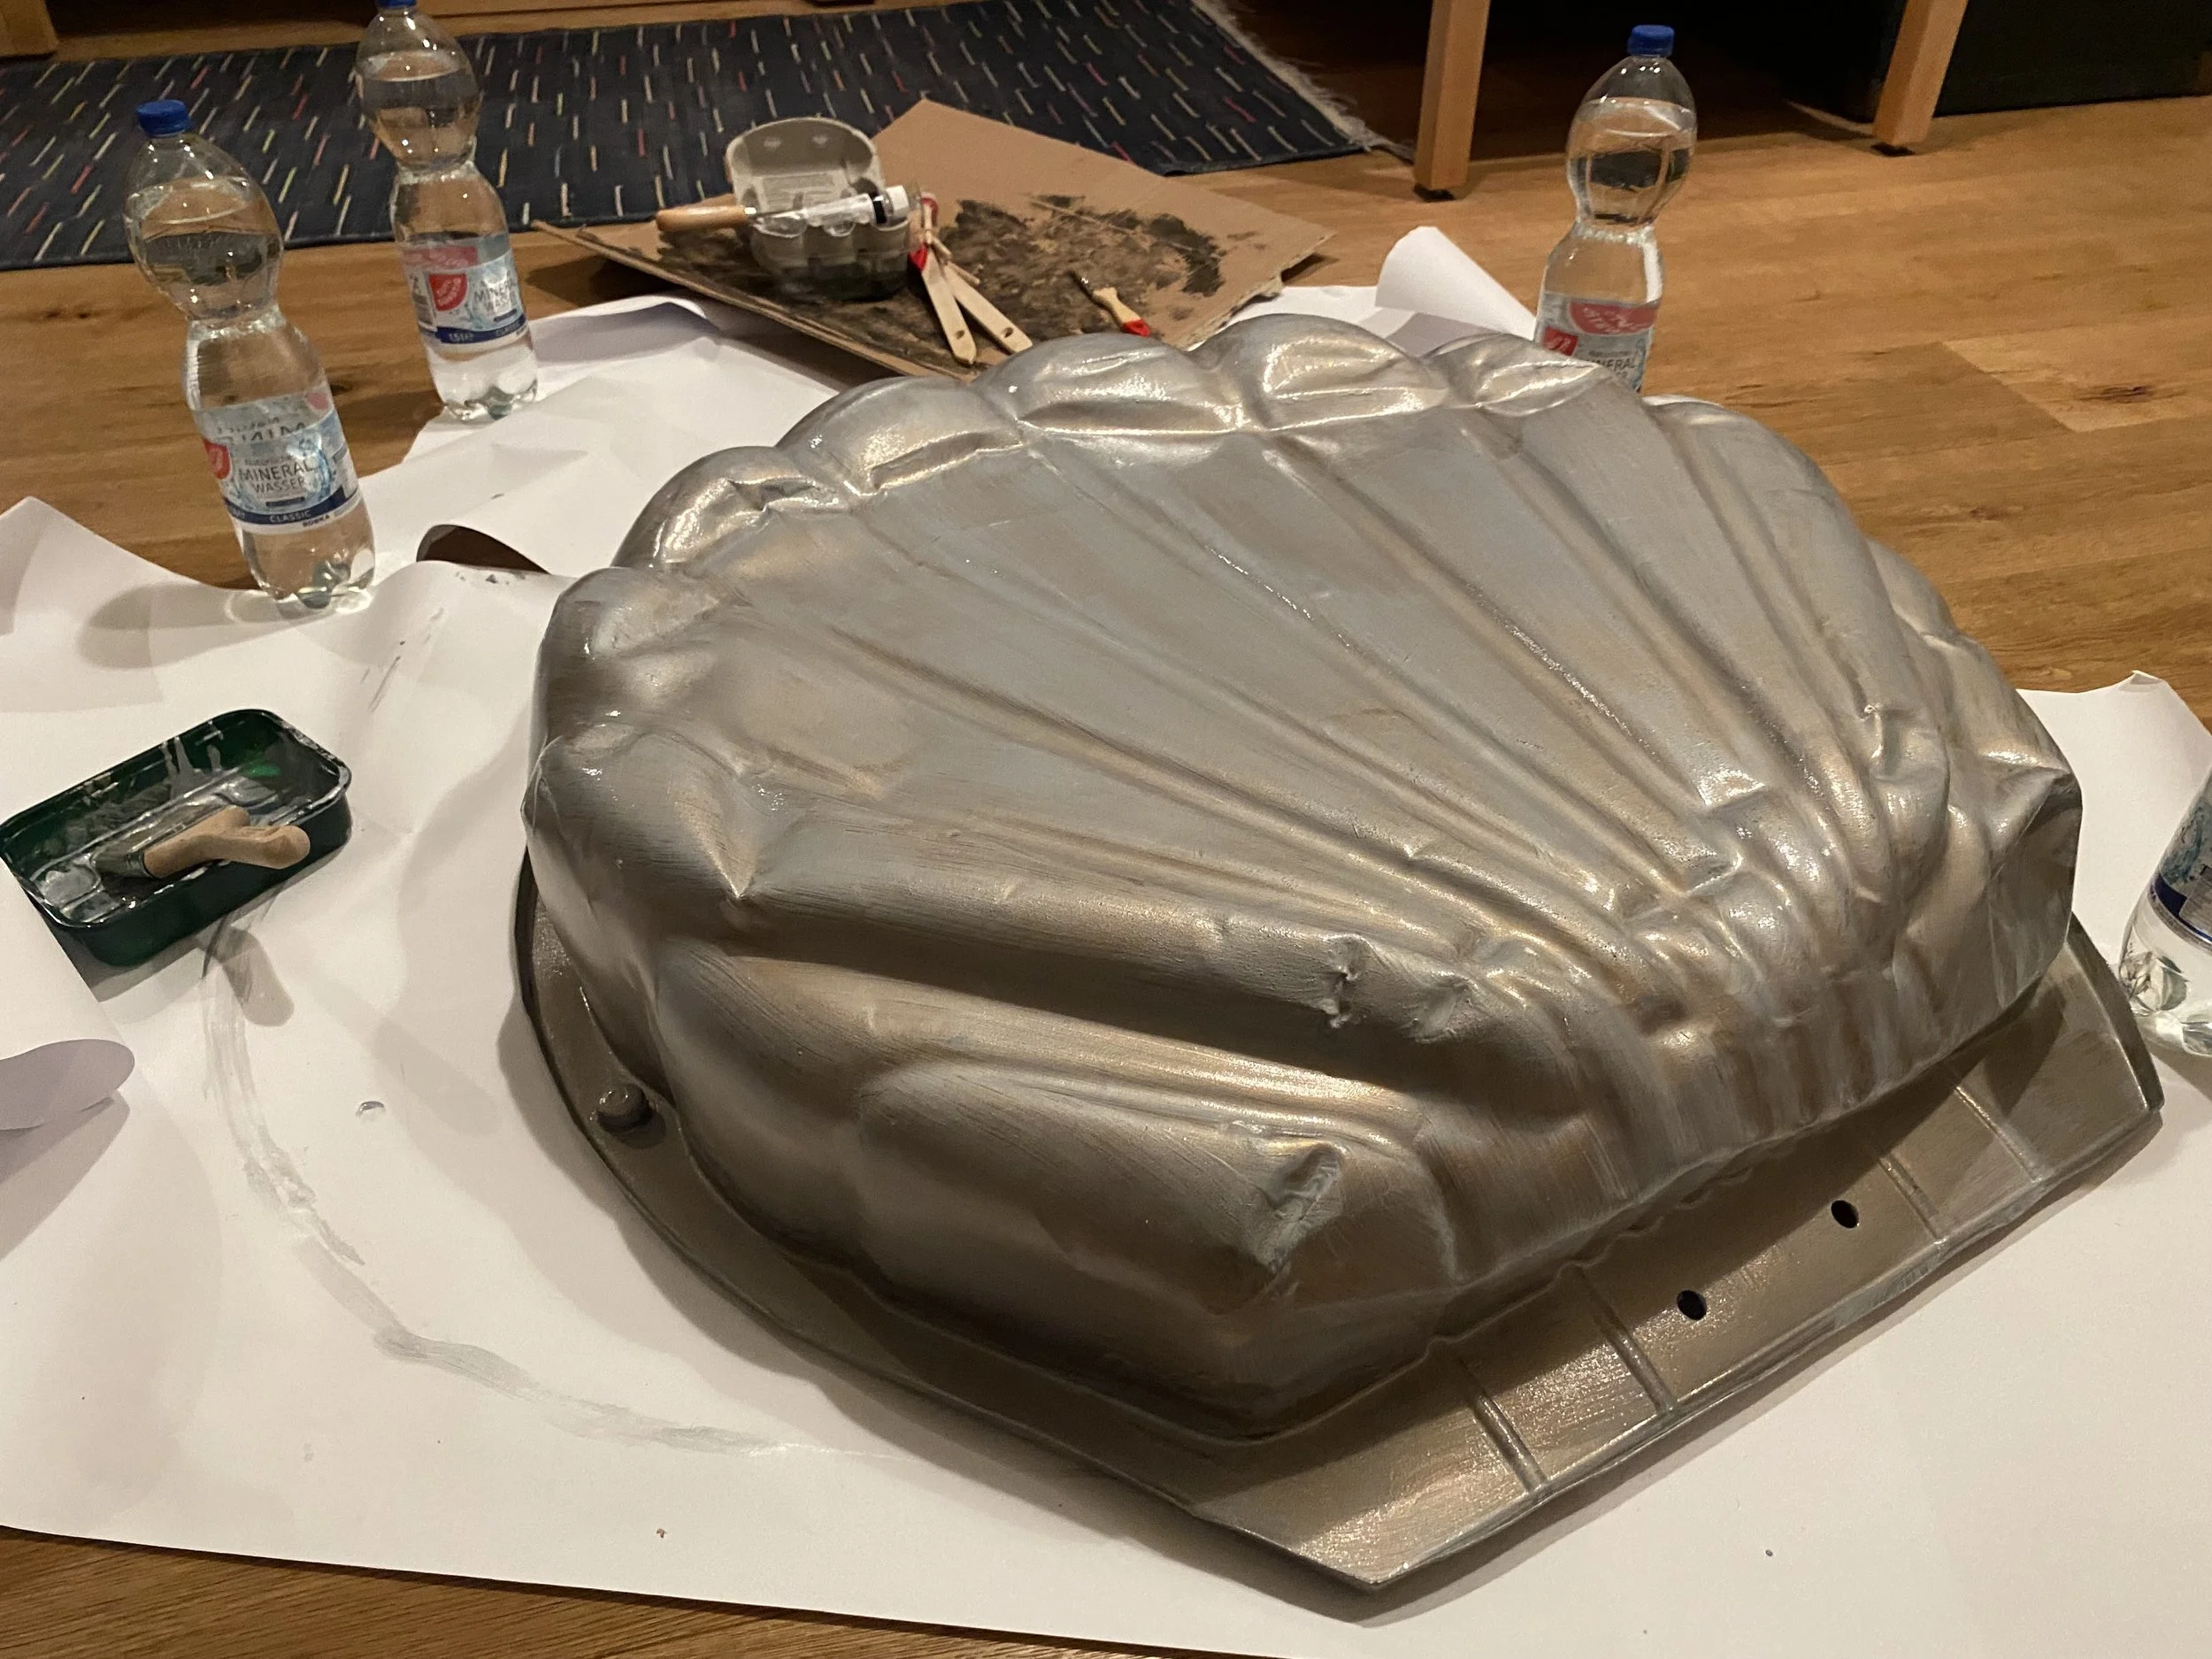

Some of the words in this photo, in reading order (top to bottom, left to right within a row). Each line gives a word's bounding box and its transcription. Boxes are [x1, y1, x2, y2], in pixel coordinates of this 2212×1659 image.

[238, 461, 315, 480] MINERAL
[251, 475, 305, 493] WASSER
[269, 510, 311, 524] CLASSIC
